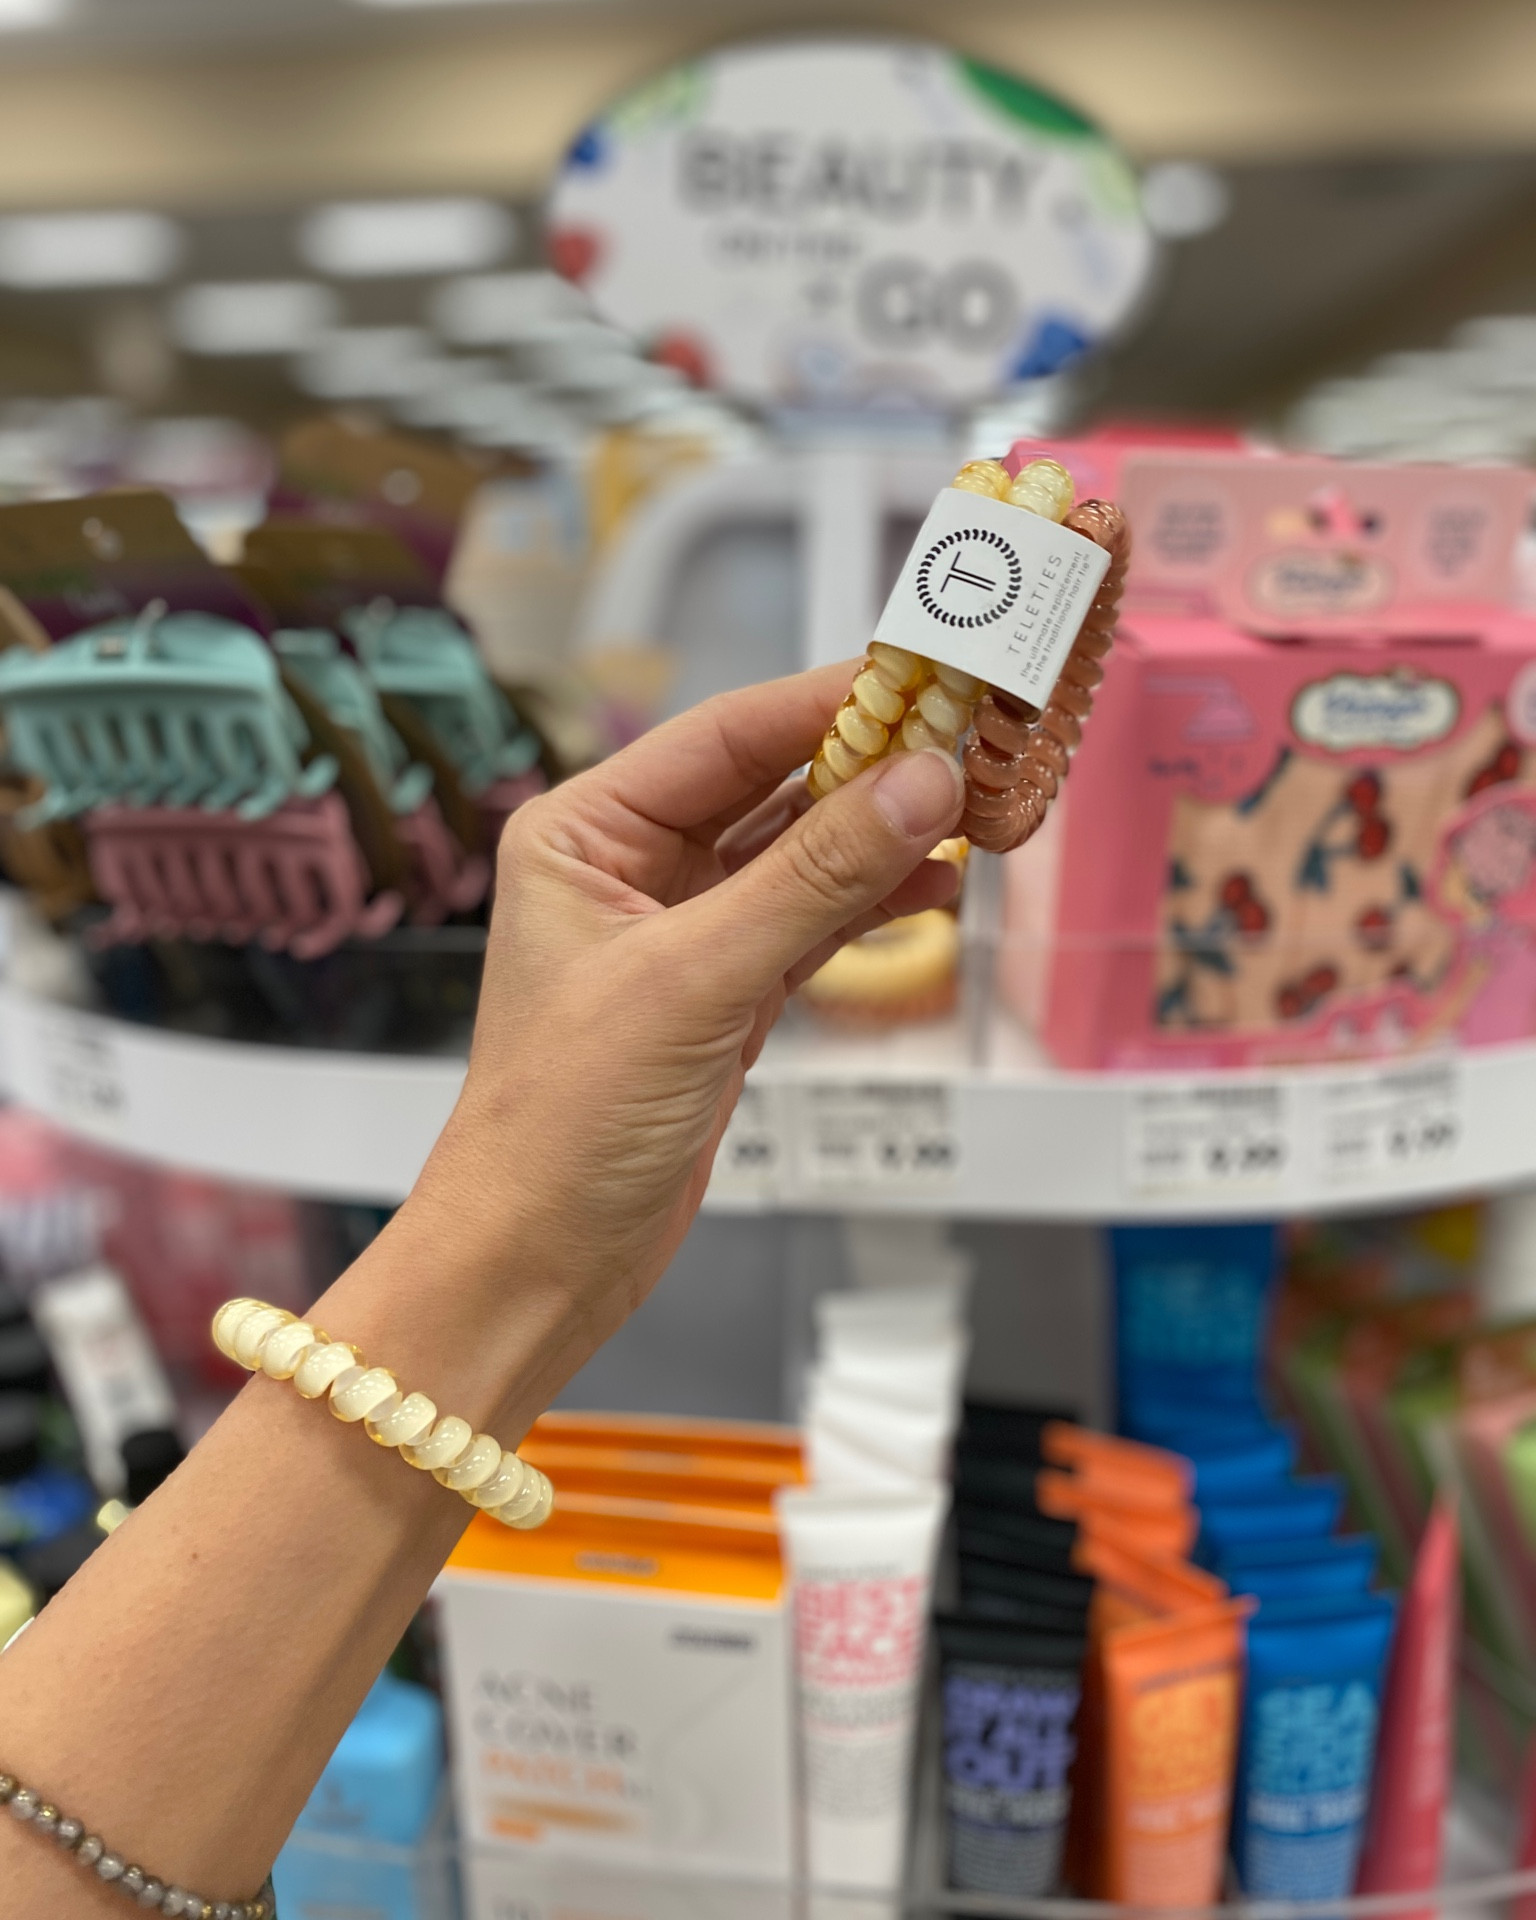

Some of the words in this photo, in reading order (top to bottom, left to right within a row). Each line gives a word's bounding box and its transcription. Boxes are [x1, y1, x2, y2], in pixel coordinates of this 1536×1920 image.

[678, 130, 1042, 224] BEAUTY
[857, 258, 1018, 353] GO
[1008, 554, 1062, 655] TELETIES
[1020, 661, 1033, 679] the
[1030, 618, 1053, 660] ultimate
[1049, 551, 1083, 617] replacement
[1028, 673, 1040, 686] to
[1034, 653, 1049, 673] the
[1043, 599, 1073, 653] traditional
[1067, 578, 1082, 601] hair
